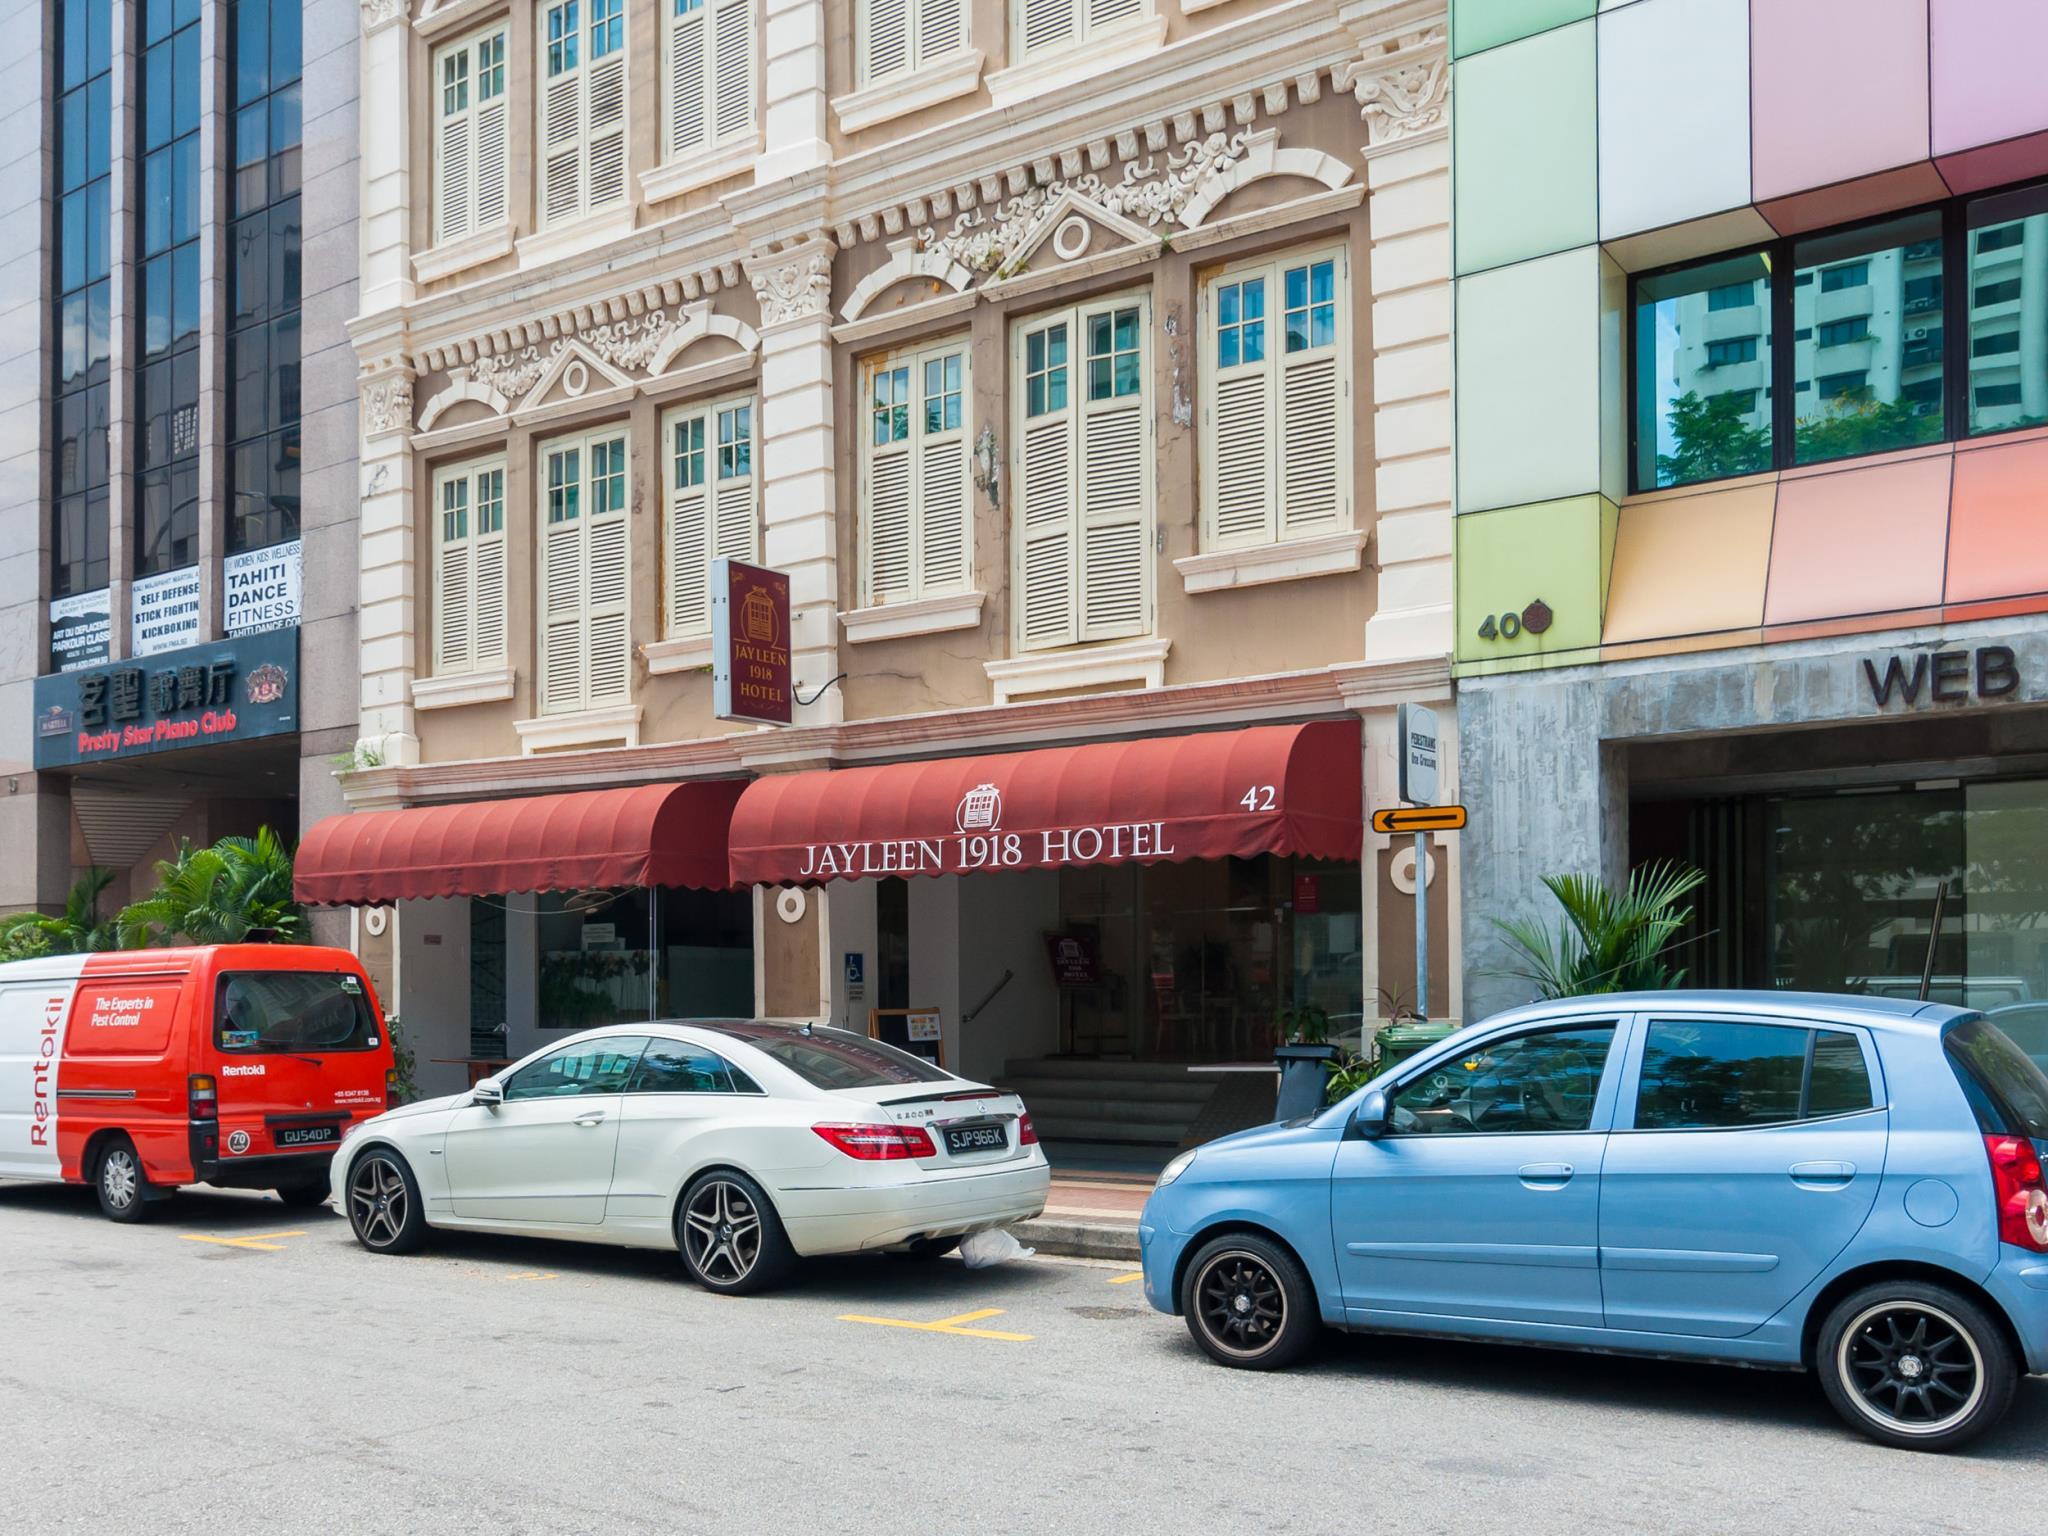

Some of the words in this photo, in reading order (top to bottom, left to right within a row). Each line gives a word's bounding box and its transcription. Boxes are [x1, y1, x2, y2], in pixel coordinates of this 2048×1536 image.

[272, 543, 301, 559] WELLNESS
[229, 563, 285, 589] TAHITI
[141, 592, 160, 606] SELF
[162, 583, 199, 601] DEFENSE
[229, 583, 287, 608] DANCE
[135, 608, 162, 624] STICK
[229, 600, 294, 627] FITNESS
[141, 618, 197, 640] KICKBOXING
[1477, 612, 1521, 641] 40
[52, 635, 86, 653] PARKOUR
[735, 644, 787, 667] JAYLEEN
[750, 665, 773, 681] 1918
[1863, 645, 2020, 706] WEB
[741, 682, 784, 703] HOTEL
[78, 729, 121, 753] Pretty
[123, 725, 154, 747] Star
[155, 718, 198, 741] Piano
[201, 708, 237, 735] Club
[1240, 785, 1276, 812] 42
[800, 839, 946, 876] JAYLEEN
[956, 833, 1024, 869] 1918
[1041, 822, 1175, 863] HOTEL
[96, 997, 111, 1011] The
[111, 997, 144, 1013] Experts
[144, 996, 154, 1009] in
[91, 1014, 109, 1027] Pest
[109, 1012, 141, 1026] Control
[31, 998, 65, 1146] Rentokil
[222, 1065, 265, 1077] Rentokil
[233, 1134, 246, 1144] 70
[950, 1128, 1002, 1148] SJP966K
